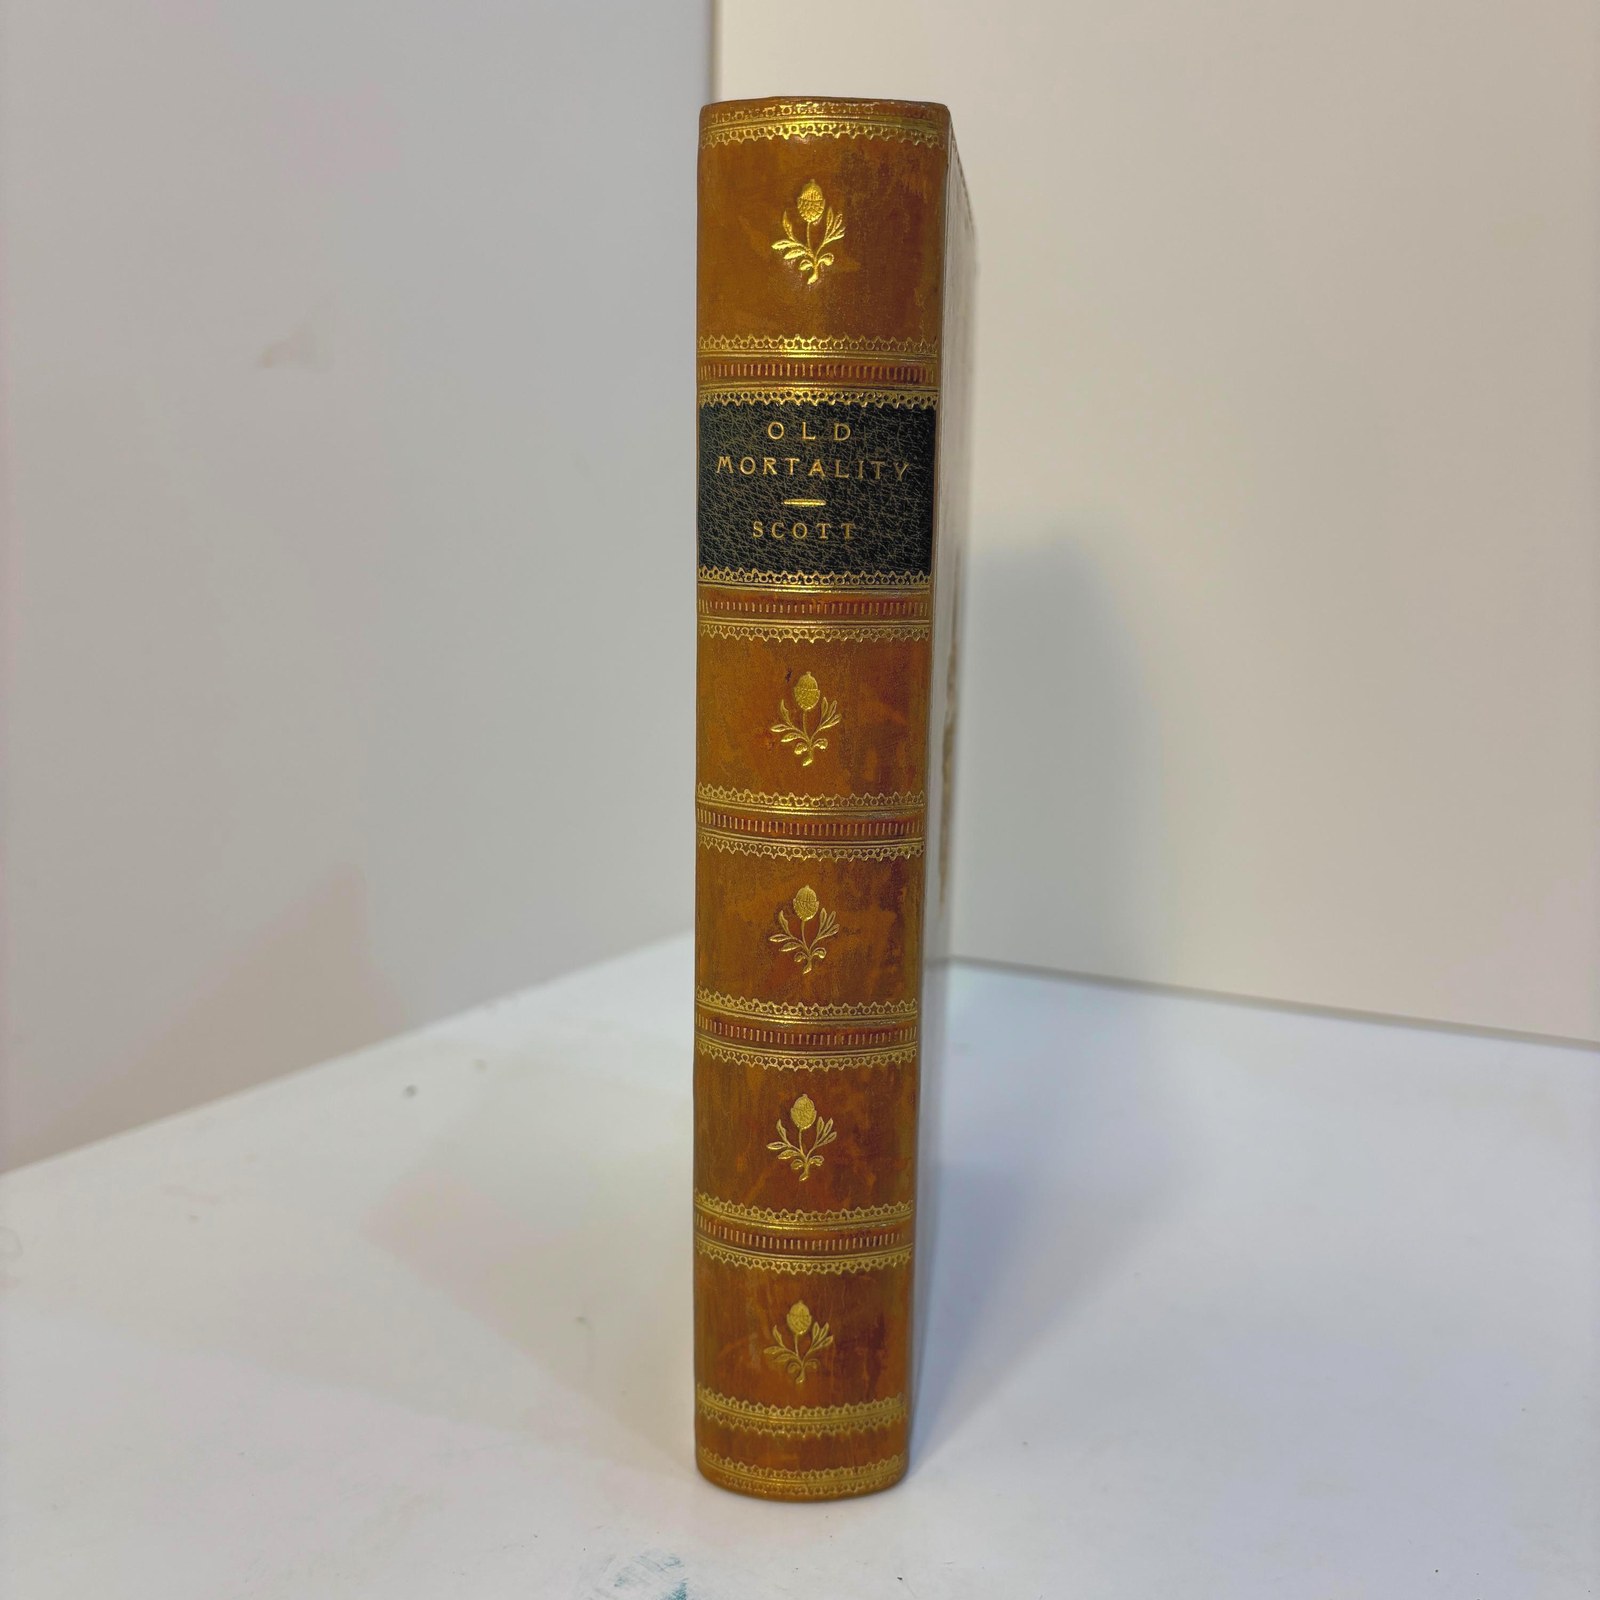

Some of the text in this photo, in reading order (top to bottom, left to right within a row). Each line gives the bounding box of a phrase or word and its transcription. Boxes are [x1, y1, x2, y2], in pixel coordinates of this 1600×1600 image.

[767, 421, 851, 441] OLD
[716, 456, 909, 480] MORTALITY
[752, 521, 856, 540] SCOTT
